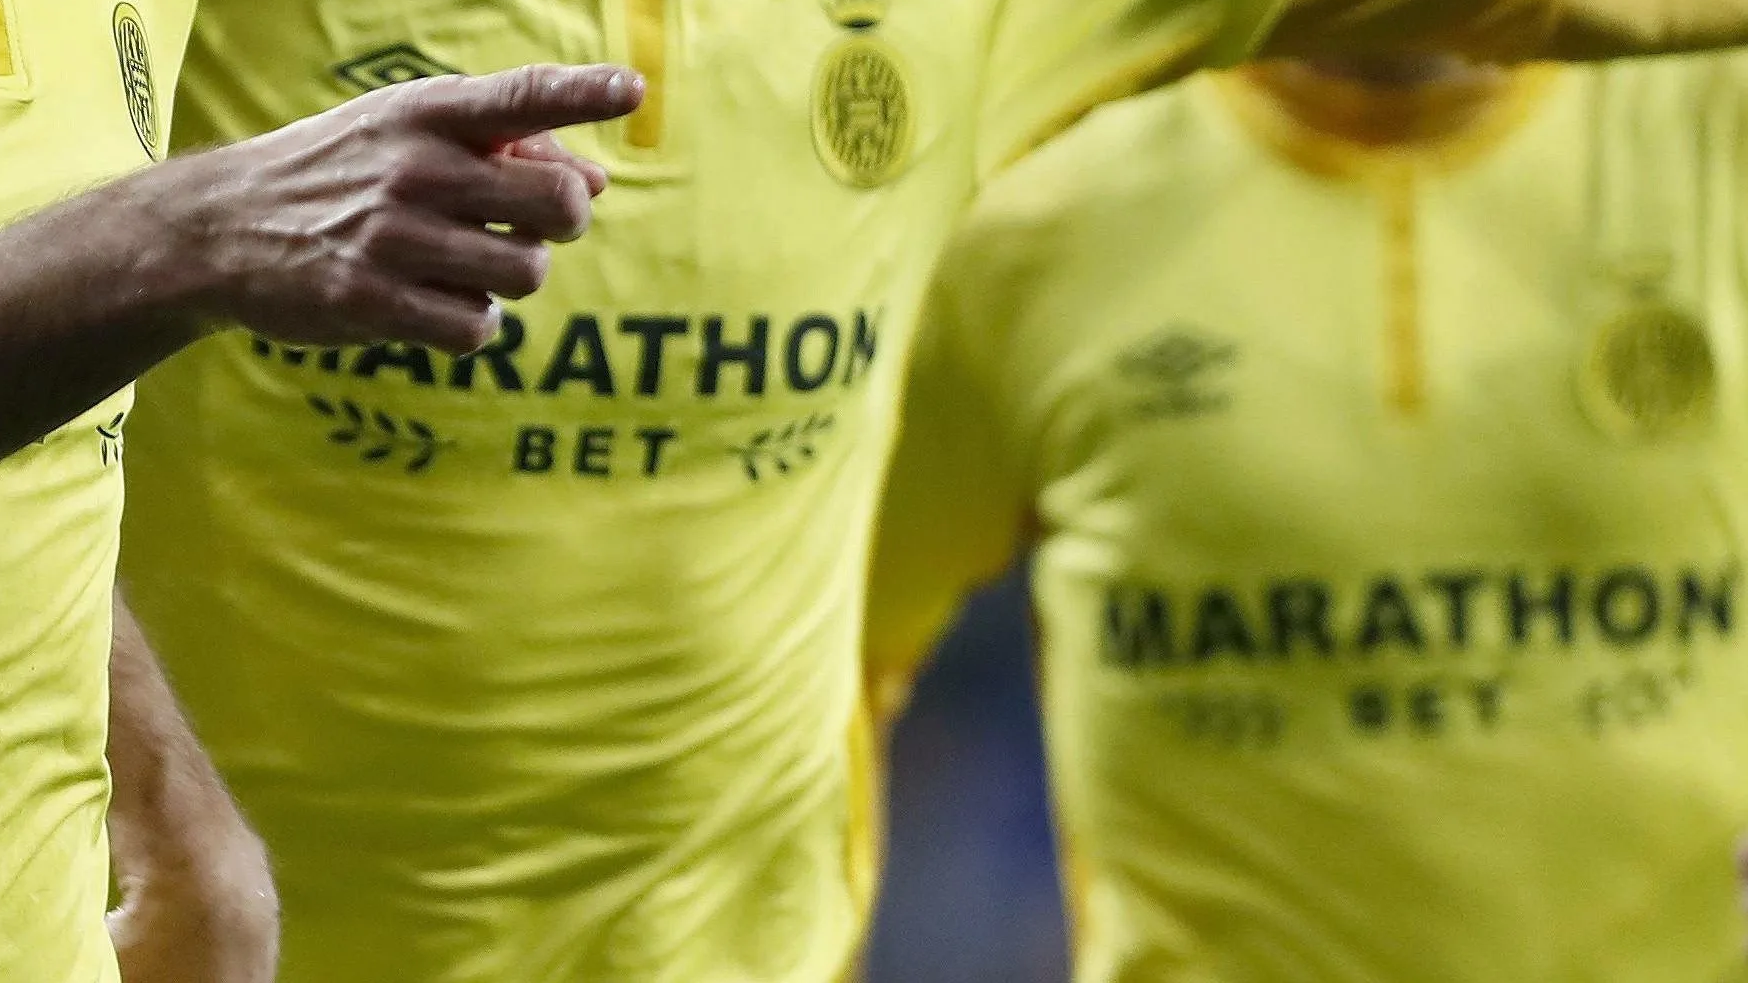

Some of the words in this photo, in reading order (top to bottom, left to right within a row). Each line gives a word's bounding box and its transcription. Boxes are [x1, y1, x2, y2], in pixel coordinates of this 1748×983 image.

[253, 306, 880, 396] ARATHON
[512, 426, 678, 477] BET
[1101, 567, 1738, 668] MARATHON
